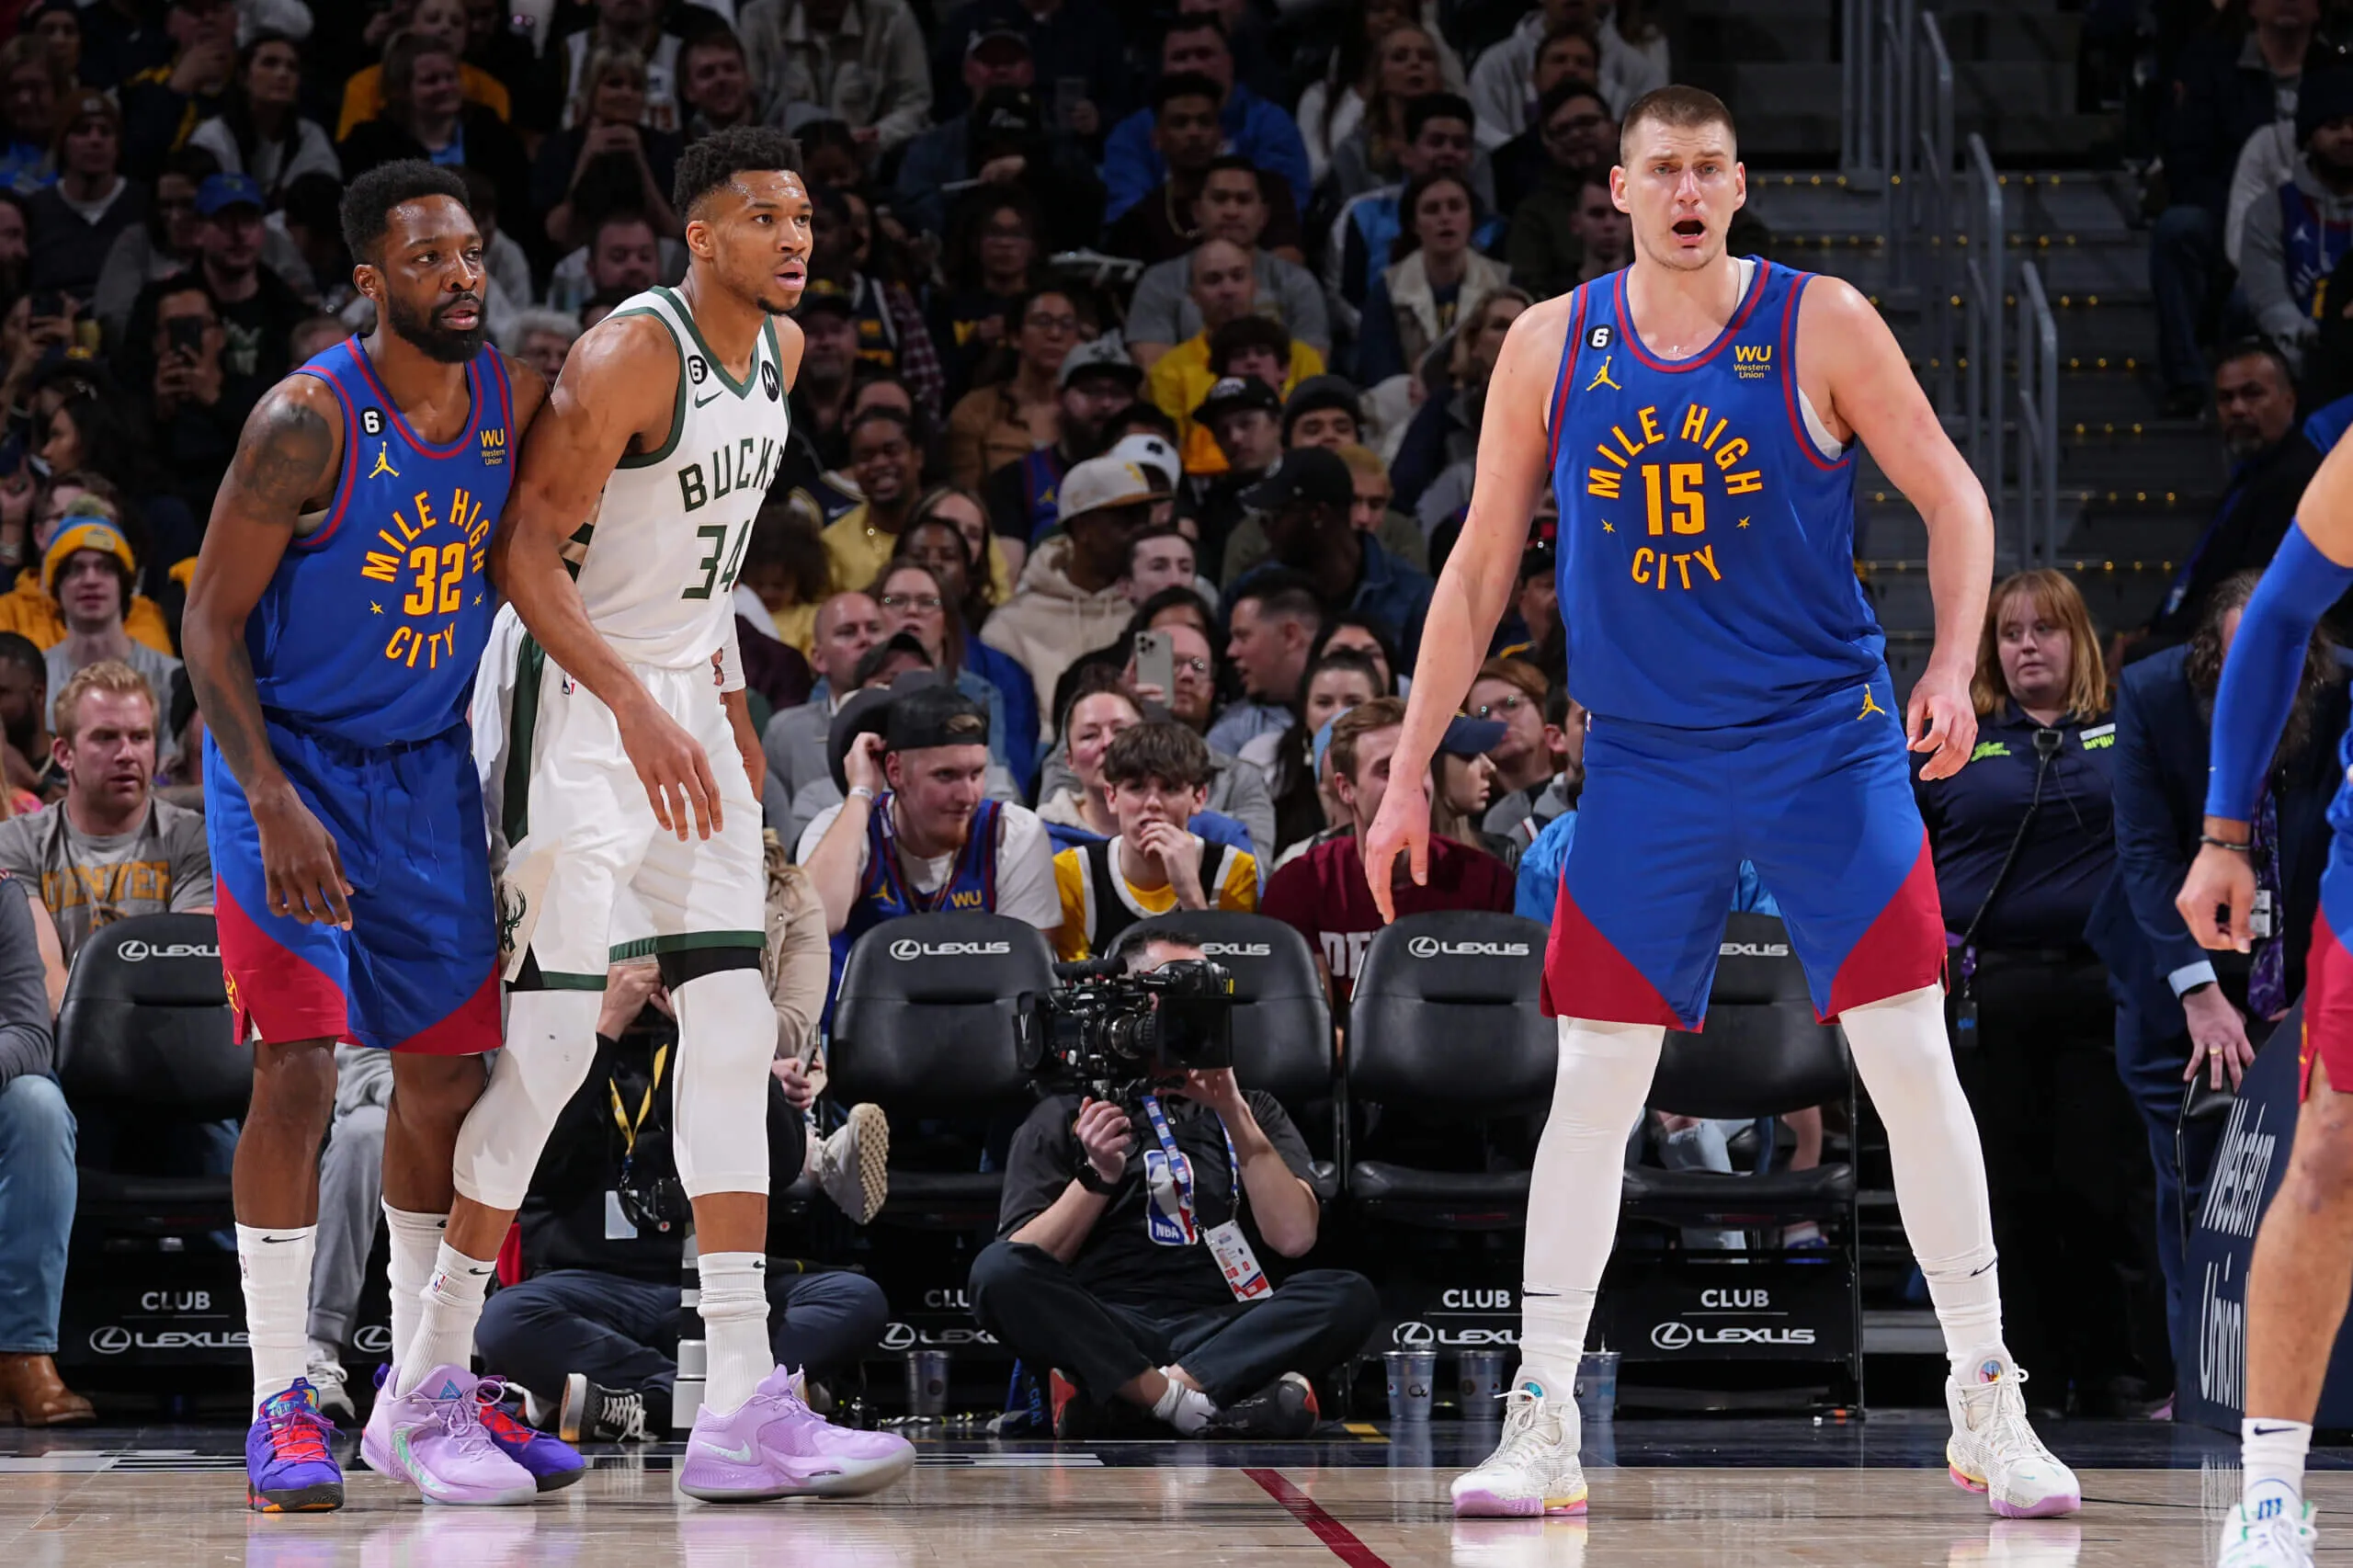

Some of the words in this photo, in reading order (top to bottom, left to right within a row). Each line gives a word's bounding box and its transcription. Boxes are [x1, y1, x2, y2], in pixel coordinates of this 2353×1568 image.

[1591, 327, 1609, 347] 6
[1734, 345, 1772, 362] WU
[688, 359, 703, 382] 6
[1733, 363, 1771, 371] Western
[1739, 370, 1765, 379] Union
[363, 411, 380, 434] 6
[480, 427, 505, 448] WU
[482, 449, 506, 458] Western
[1587, 405, 1665, 499] MILE
[1680, 403, 1763, 495] HIGH
[484, 458, 503, 466] Union
[677, 437, 784, 513] BUCKS
[1641, 462, 1705, 536] 15
[361, 491, 437, 583] MILE
[449, 487, 490, 574] HIGH
[681, 518, 751, 600] 34
[1631, 544, 1722, 590] CITY
[403, 542, 467, 617] 32
[384, 621, 456, 670] CITY
[42, 860, 171, 914] DENVER
[951, 889, 983, 908] WU
[151, 944, 222, 957] LEXU
[923, 941, 1010, 956] LEXUS
[1199, 942, 1271, 956] EXUS
[1441, 941, 1529, 956] LEXUS
[1719, 942, 1790, 957] EXUS
[2200, 1097, 2277, 1239] Western
[1155, 1222, 1180, 1240] NBA
[142, 1290, 211, 1311] CLUB
[925, 1289, 971, 1307] CLU
[1442, 1289, 1512, 1309] CLUB
[1700, 1289, 1769, 1308] CLUB
[135, 1332, 251, 1347] LEXUS
[1438, 1329, 1522, 1345] LEXU
[1697, 1328, 1816, 1345] LEXUS
[2200, 1251, 2241, 1411] Union
